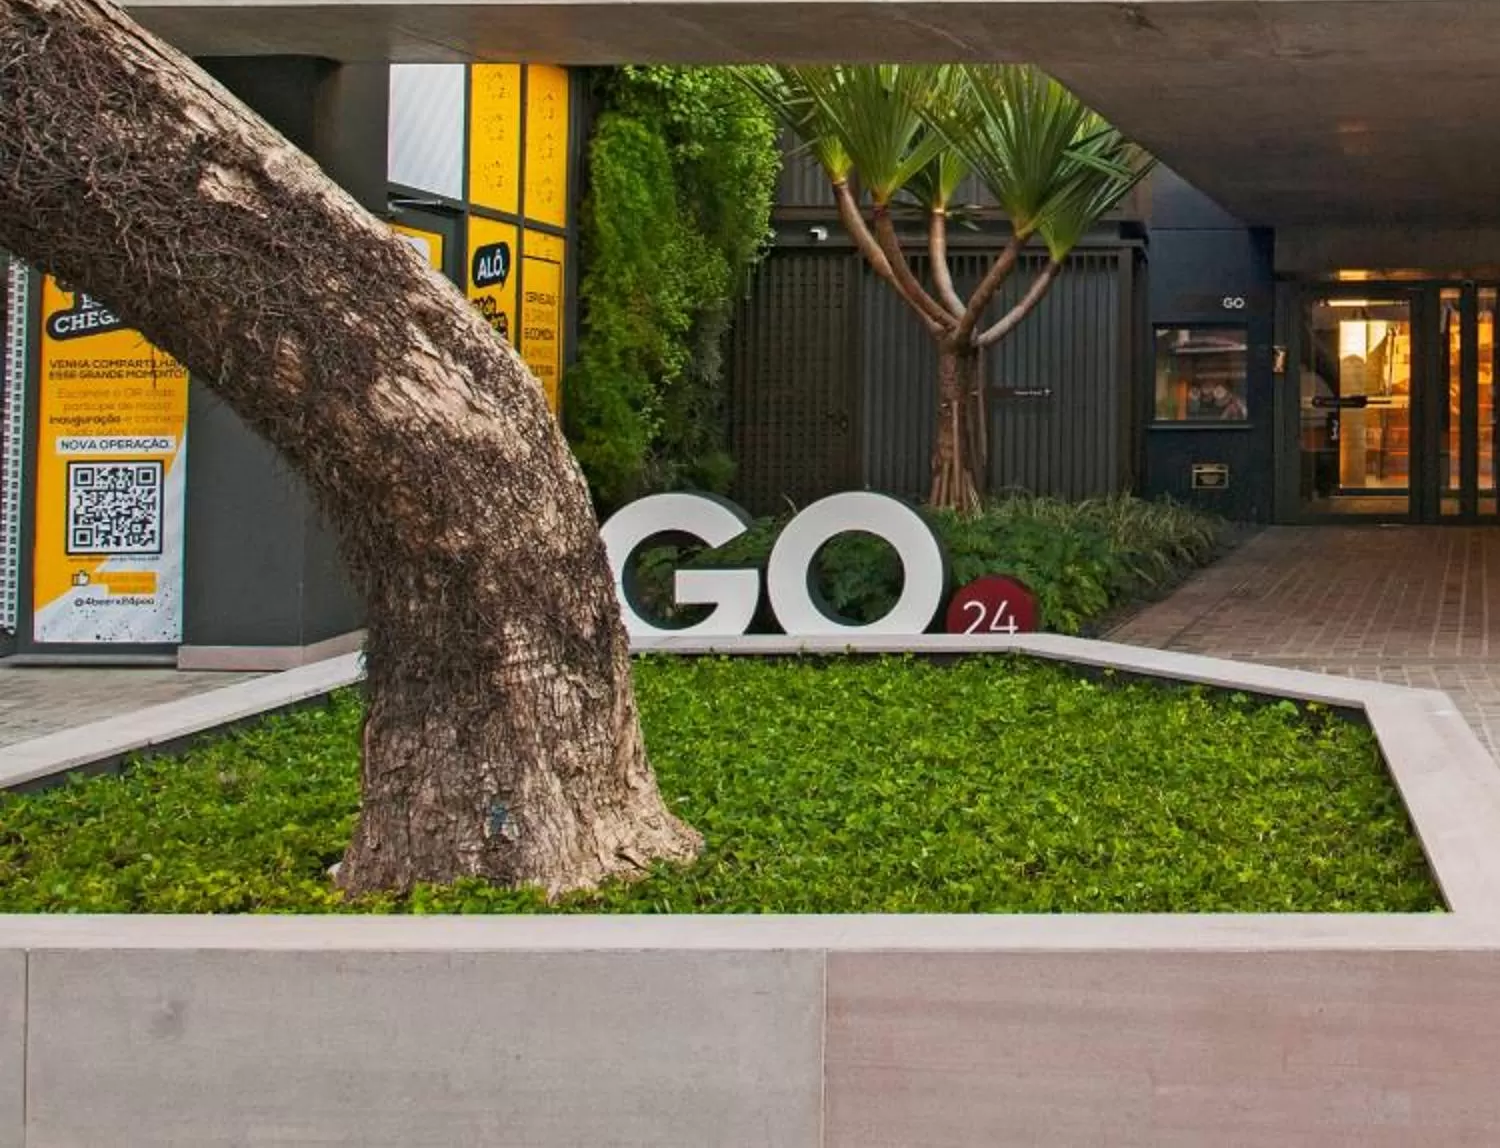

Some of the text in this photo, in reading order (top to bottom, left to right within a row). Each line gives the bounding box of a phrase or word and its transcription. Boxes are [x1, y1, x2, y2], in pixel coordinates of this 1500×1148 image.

[1223, 297, 1245, 309] GO
[54, 309, 120, 333] CHEG
[49, 358, 180, 369] VENHA COMPARTILHA
[61, 439, 97, 450] NOVA
[598, 491, 1019, 636] GO 24
